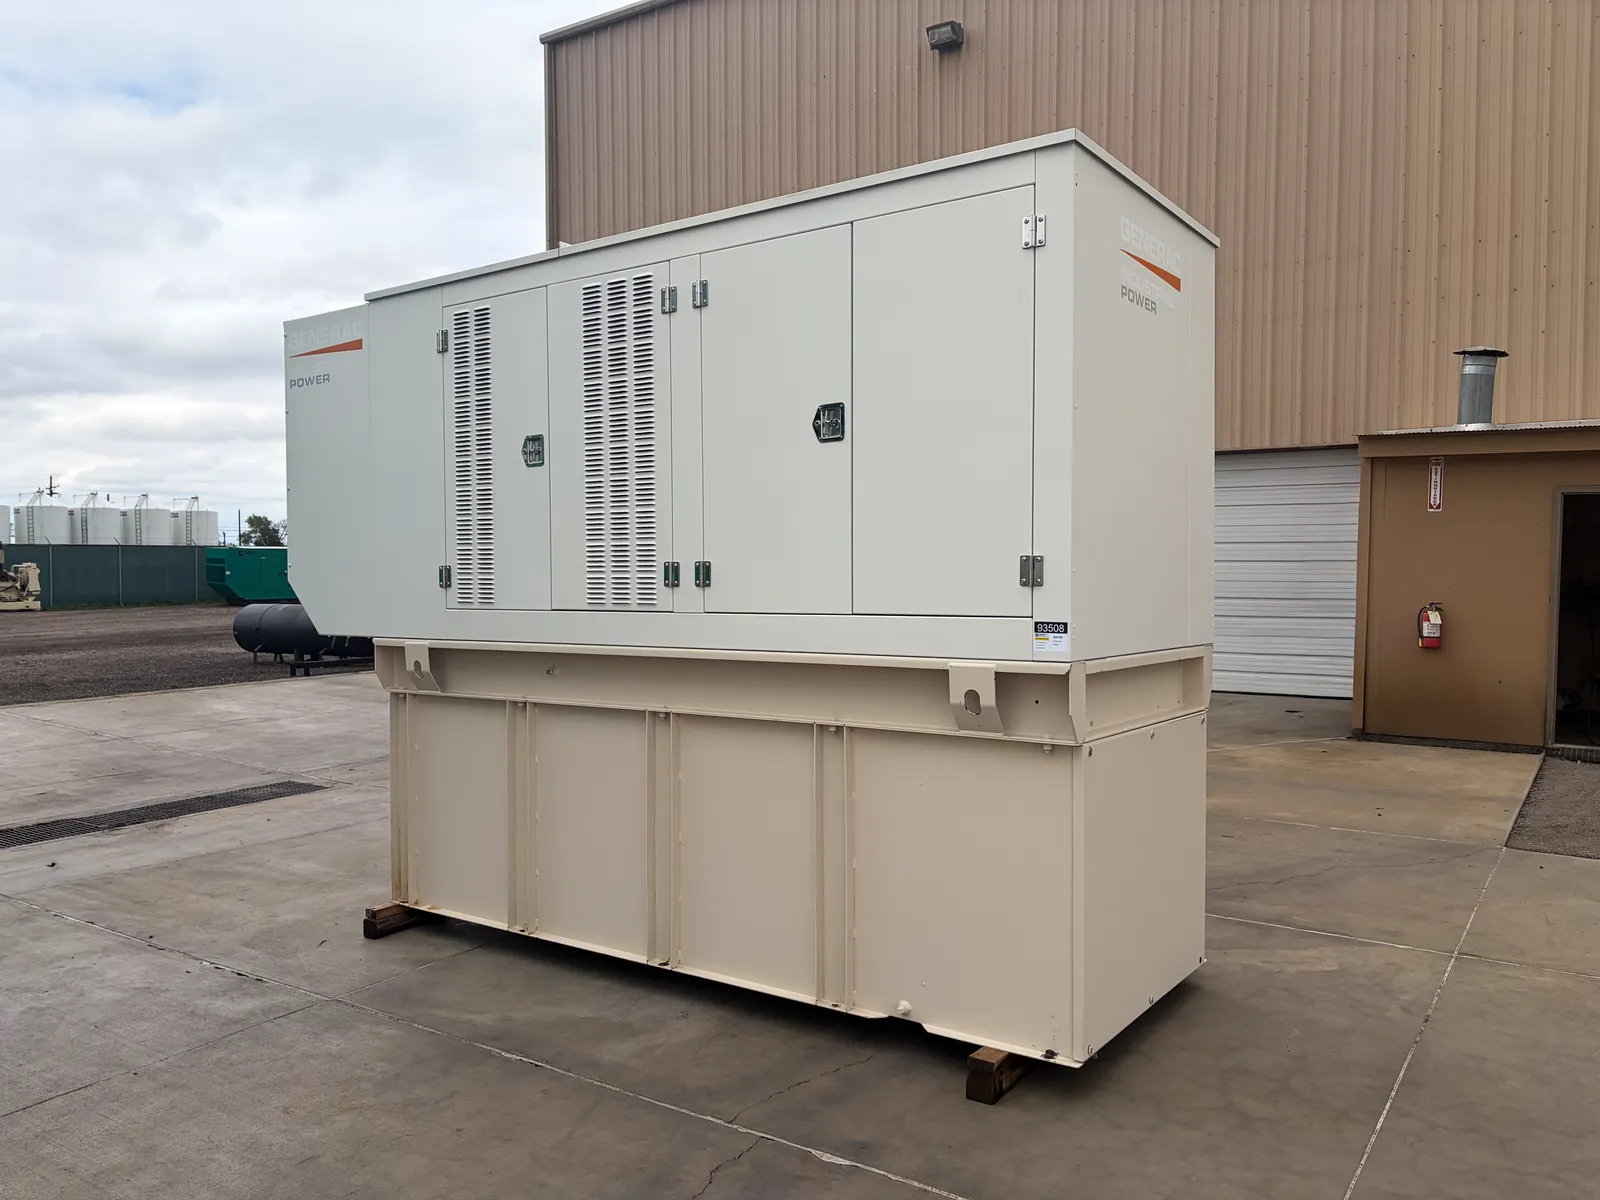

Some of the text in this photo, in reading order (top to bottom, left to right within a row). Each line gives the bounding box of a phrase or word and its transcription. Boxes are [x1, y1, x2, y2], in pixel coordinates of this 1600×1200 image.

[1120, 216, 1181, 275] GENERAC
[1121, 284, 1157, 315] POWER
[289, 321, 364, 349] GENERAC
[290, 373, 330, 389] POWER
[1037, 623, 1065, 633] 93508
